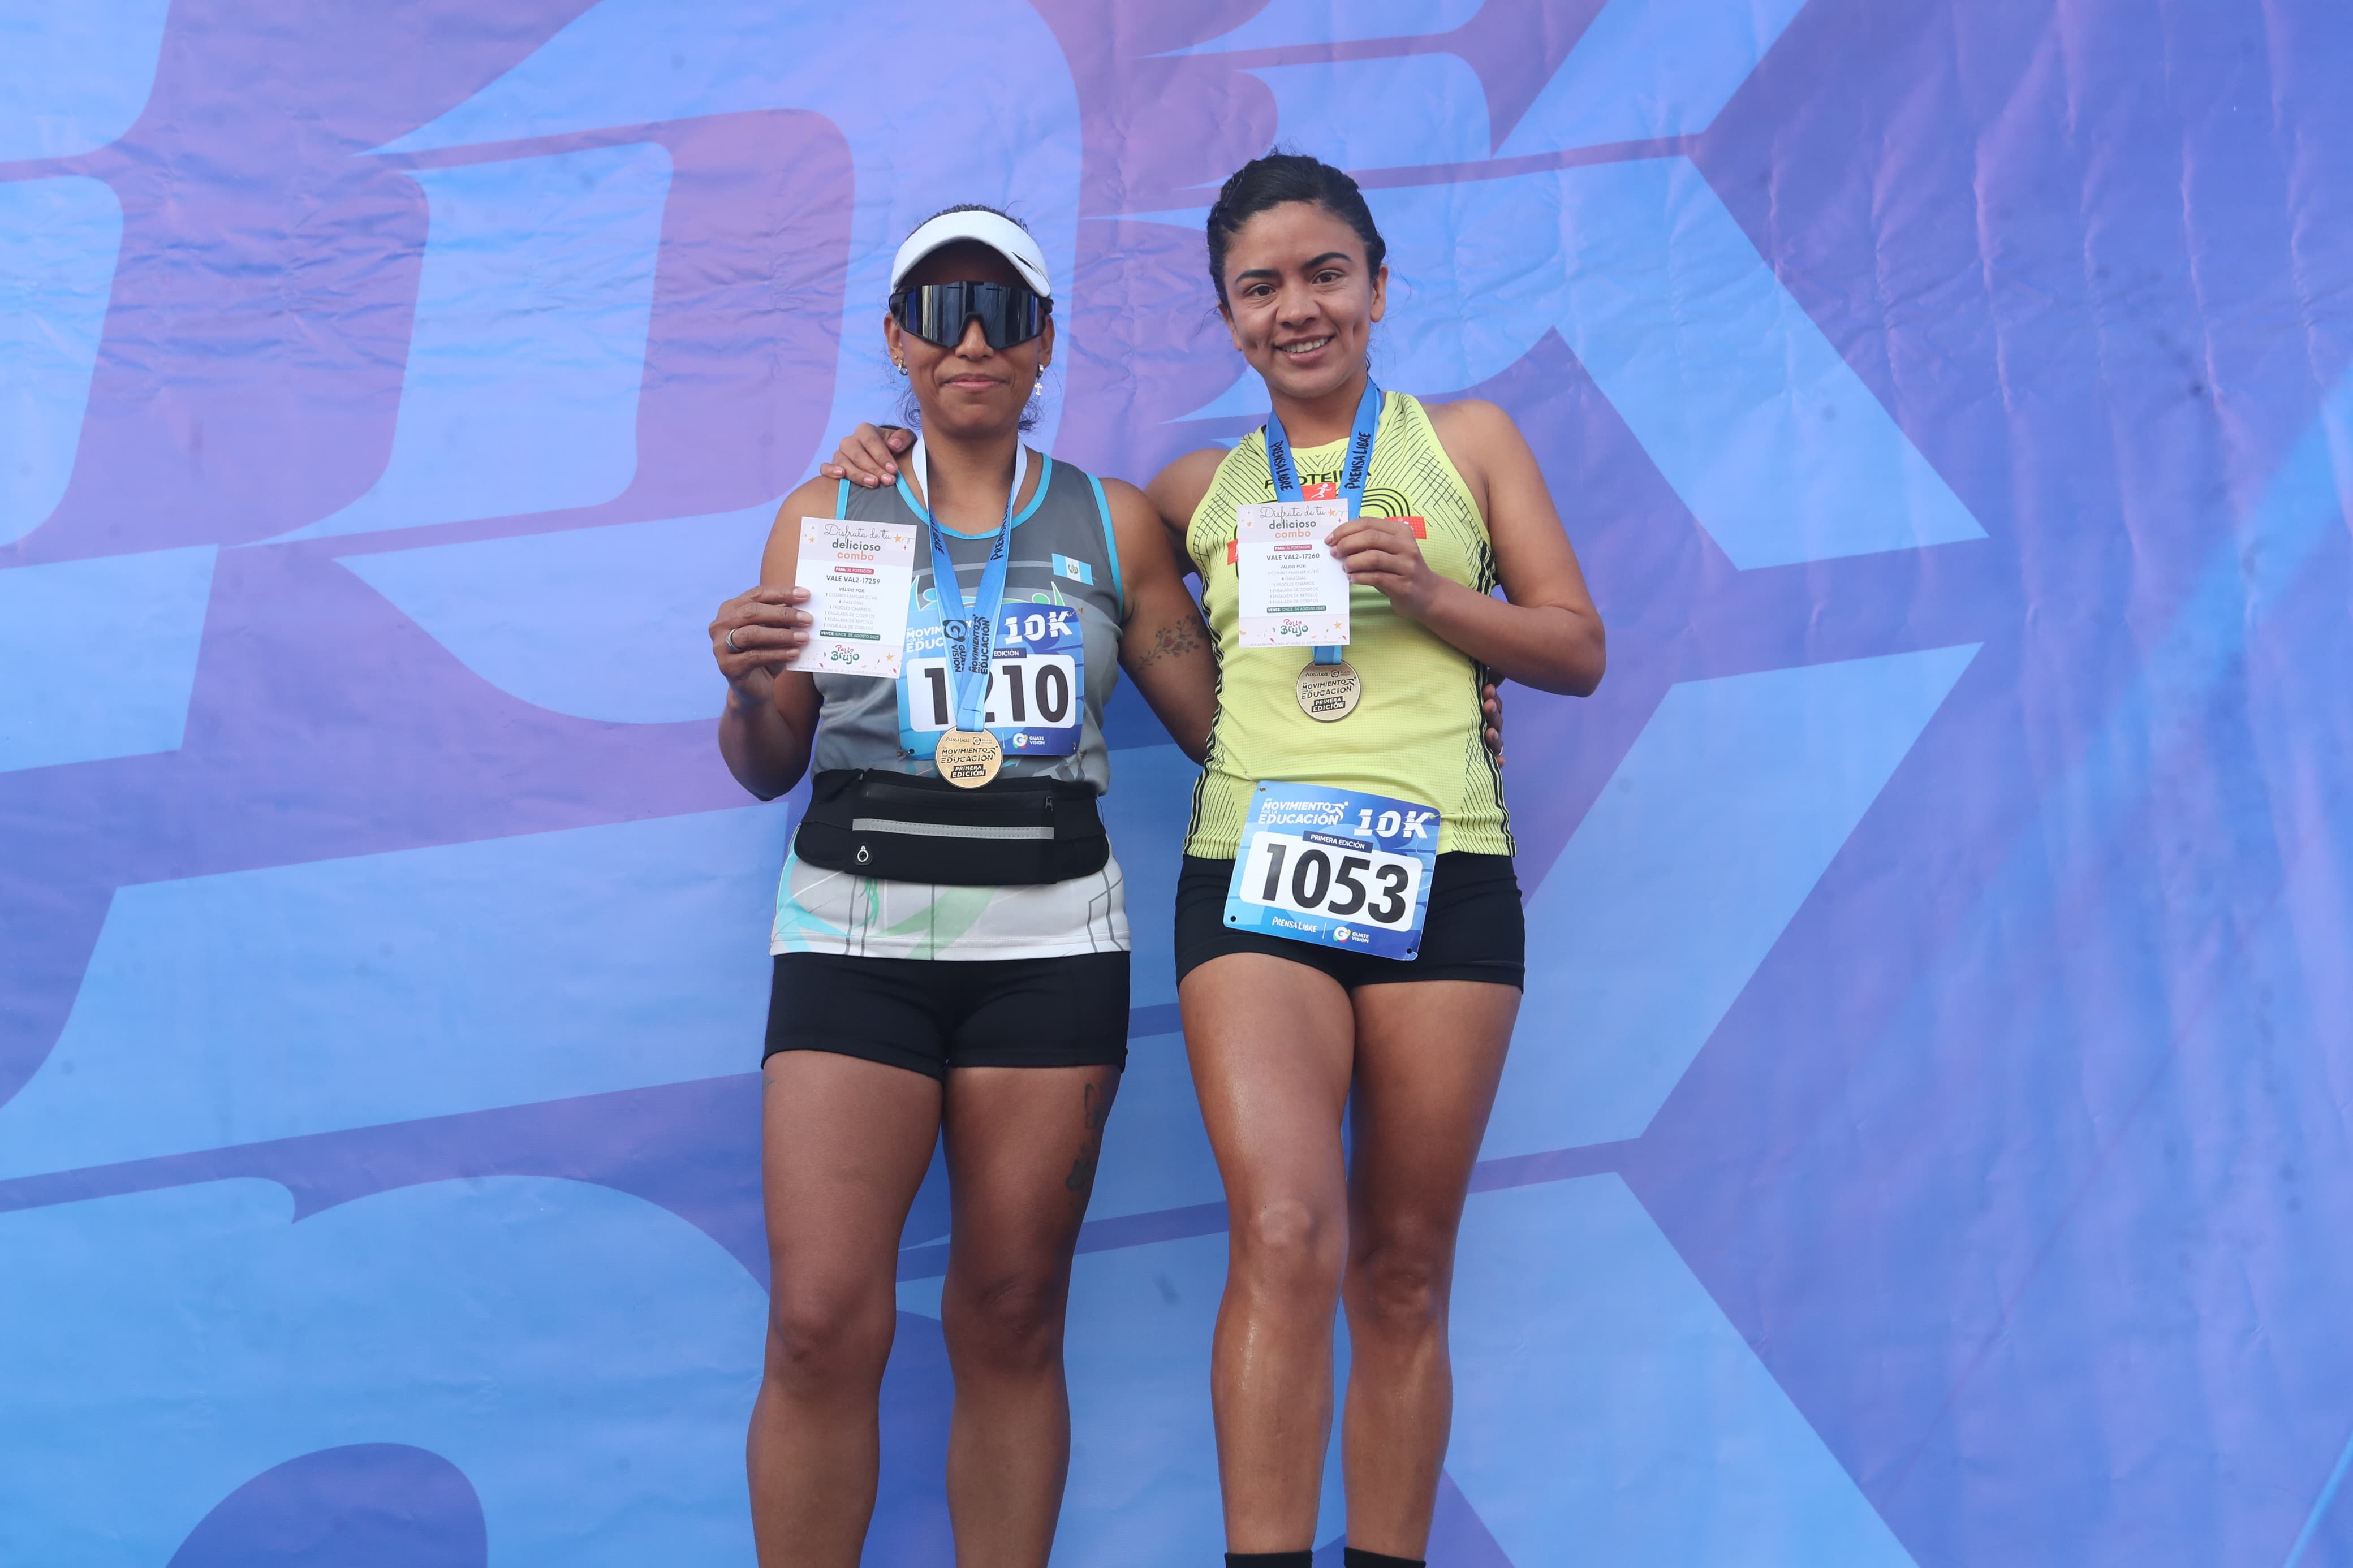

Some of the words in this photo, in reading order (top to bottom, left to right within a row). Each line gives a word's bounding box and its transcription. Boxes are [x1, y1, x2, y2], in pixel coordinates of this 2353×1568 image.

[1260, 506, 1303, 523] Disfruta
[1304, 505, 1315, 516] de
[1314, 506, 1326, 515] tu
[1269, 520, 1316, 529] delicioso
[824, 523, 868, 543] Disfruta
[870, 528, 880, 539] de
[880, 529, 892, 539] tu
[1275, 528, 1311, 538] combo
[832, 538, 881, 551] delicioso
[837, 550, 874, 561] combo
[1005, 611, 1073, 645] 10K
[1283, 619, 1302, 627] Pollo
[1281, 625, 1308, 637] Brujo
[835, 644, 854, 654] Pollo
[981, 620, 990, 675] EDUCACIÓN
[831, 651, 859, 664] Brujo
[951, 644, 962, 672] VISION
[1302, 679, 1348, 690] MOVIMIENTO
[1262, 801, 1333, 813] MOVIMIENTO
[1257, 813, 1339, 826] EDUCACIÓN
[1354, 809, 1434, 838] 10K
[1311, 834, 1337, 844] PRIMERA
[1338, 839, 1365, 849] EDICIÓN
[1262, 843, 1408, 923] 1053
